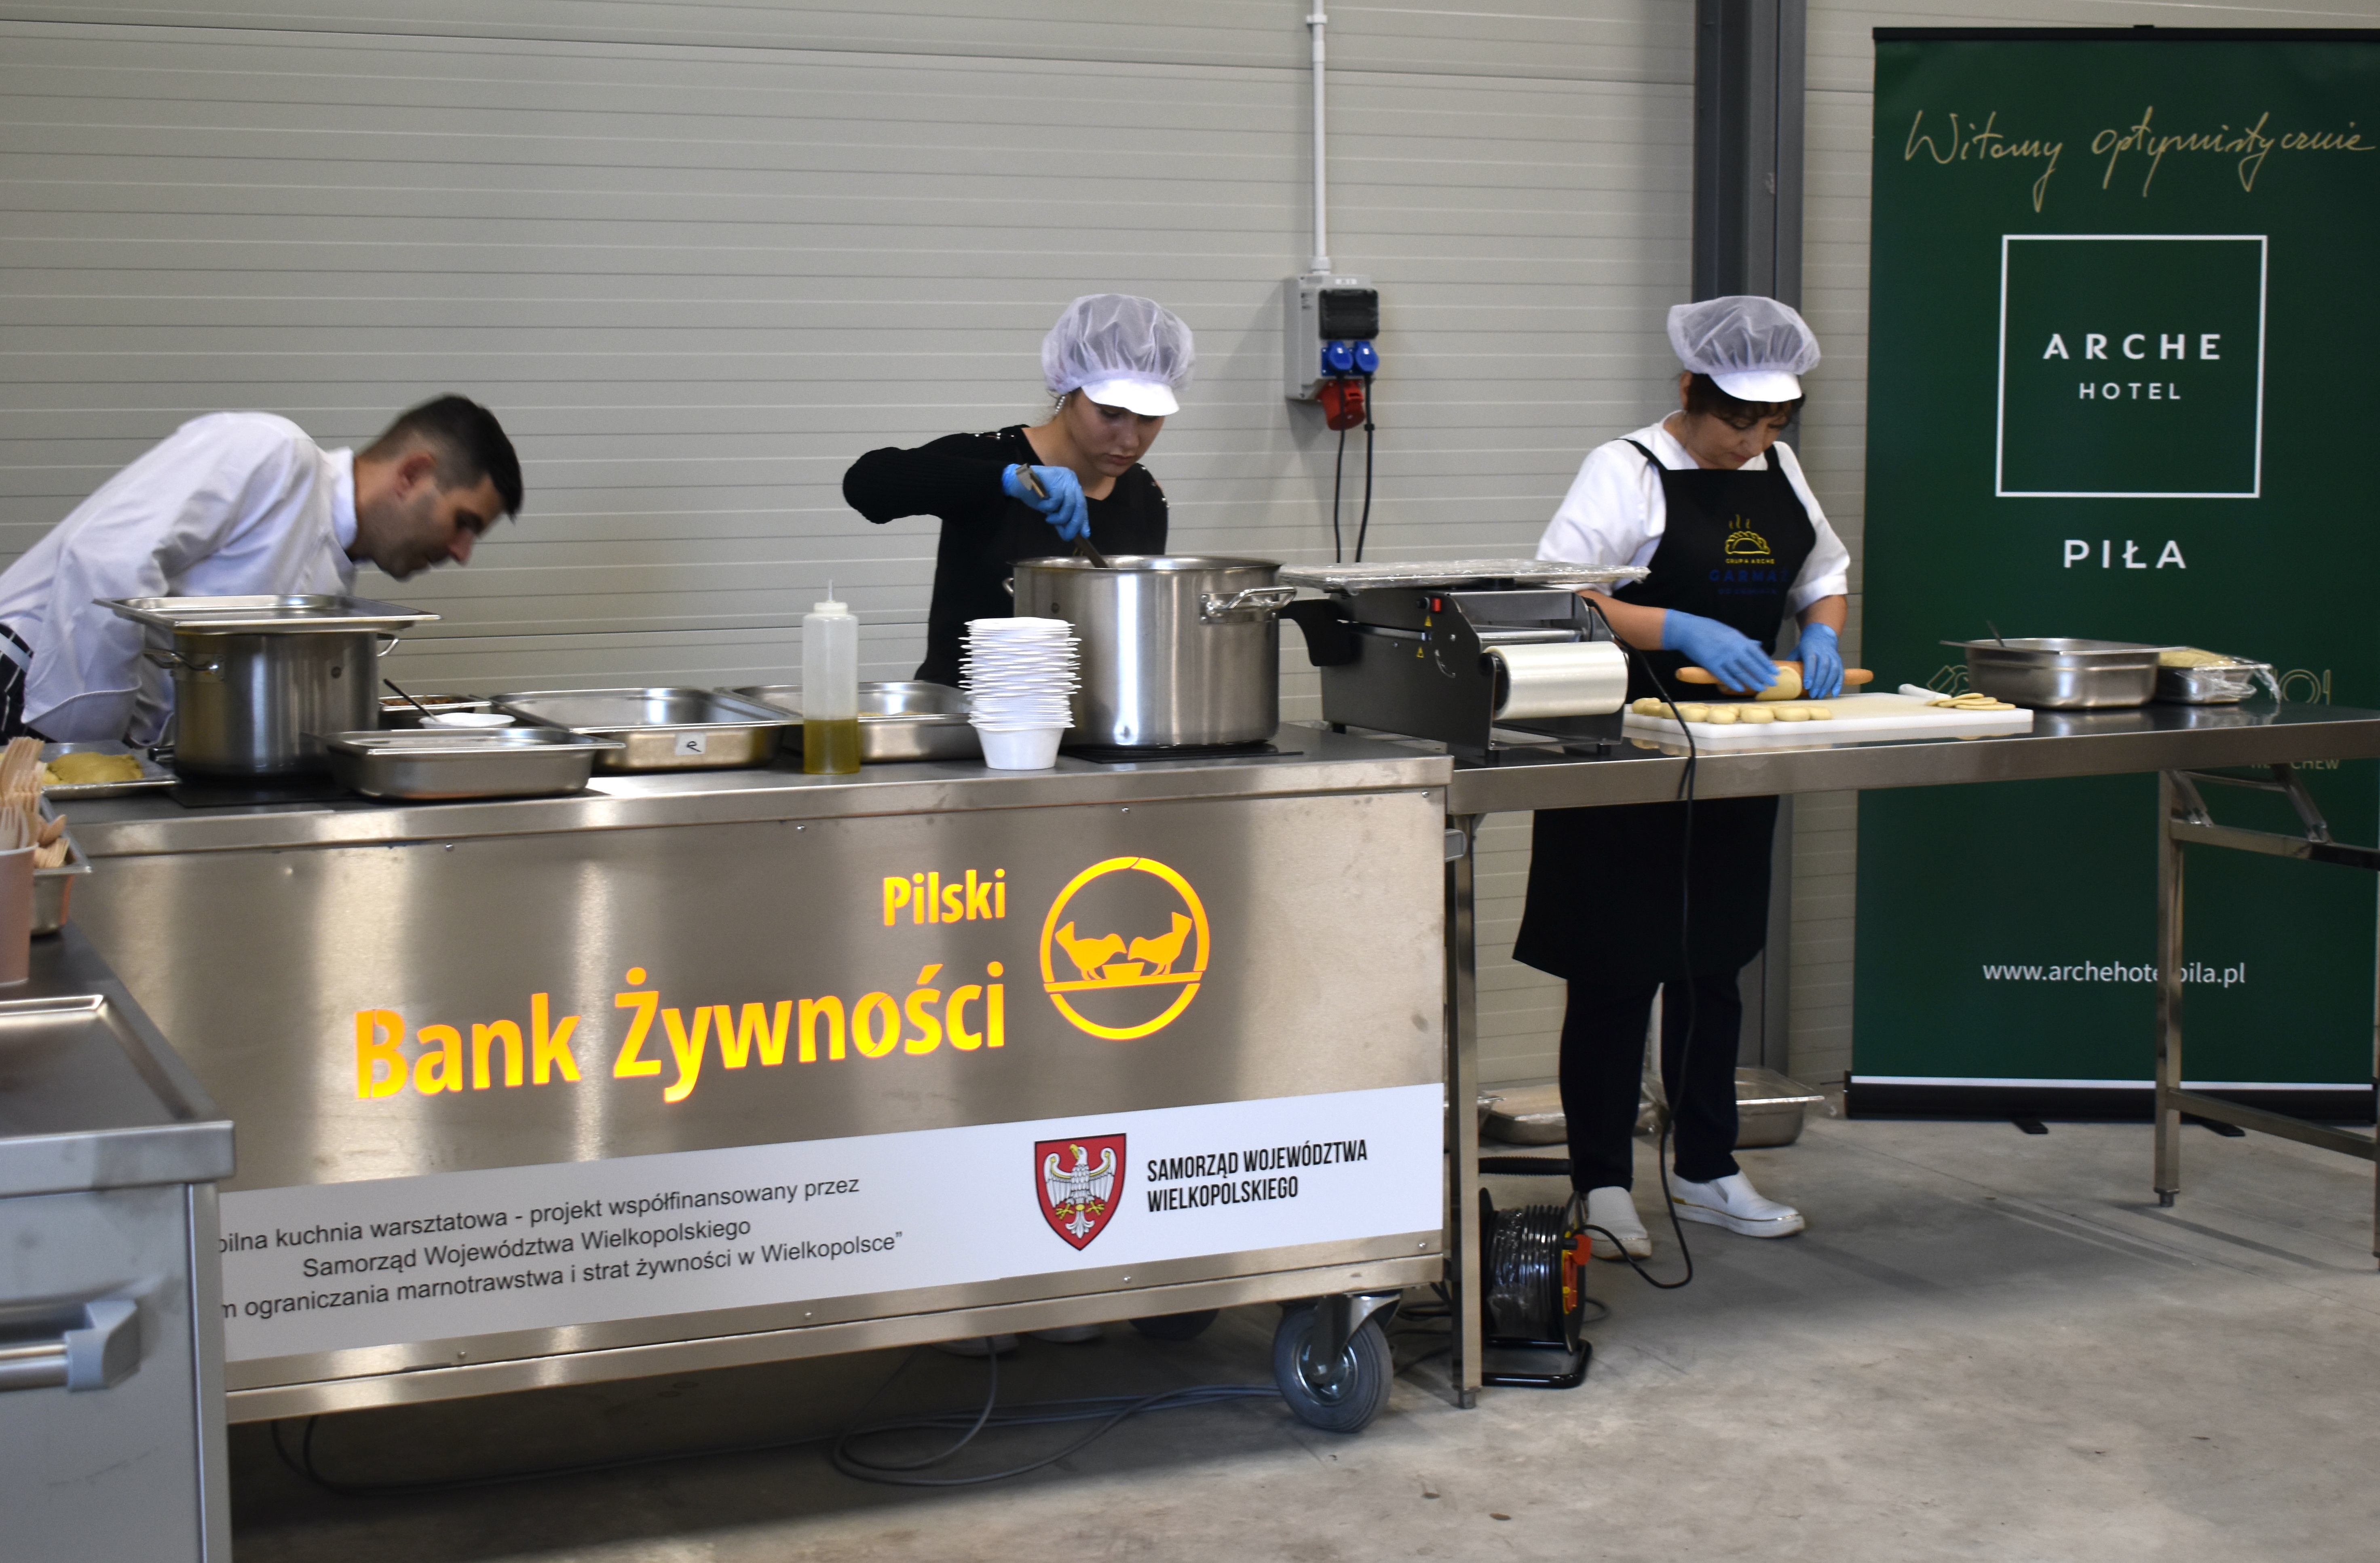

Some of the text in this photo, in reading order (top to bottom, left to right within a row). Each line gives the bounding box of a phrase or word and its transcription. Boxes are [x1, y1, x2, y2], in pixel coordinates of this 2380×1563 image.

[1905, 110, 2063, 213] Witamy
[2042, 333, 2221, 360] ARCHE
[2079, 382, 2181, 400] HOTEL
[2063, 539, 2186, 569] PIŁA
[884, 868, 1006, 926] Pilski
[355, 961, 1005, 1104] Bank Żywności
[1147, 1139, 1368, 1182] SAMORZĄD WOJEWÓDZTWA
[276, 1222, 363, 1247] kuchnia
[370, 1212, 508, 1238] warsztatowa
[530, 1199, 603, 1228] projekt
[608, 1185, 798, 1218] współfinansowany
[804, 1179, 860, 1202] przez
[1147, 1175, 1298, 1213] WIELKOPOLSKIEGO
[303, 1220, 751, 1278] Samorząd Województwa Wielkopolskiego
[244, 1285, 389, 1320] ograniczania
[397, 1270, 564, 1301] marnotrawstwa
[570, 1264, 576, 1283] i
[583, 1260, 630, 1282] strat
[636, 1249, 731, 1280] żywności
[737, 1251, 755, 1266] w
